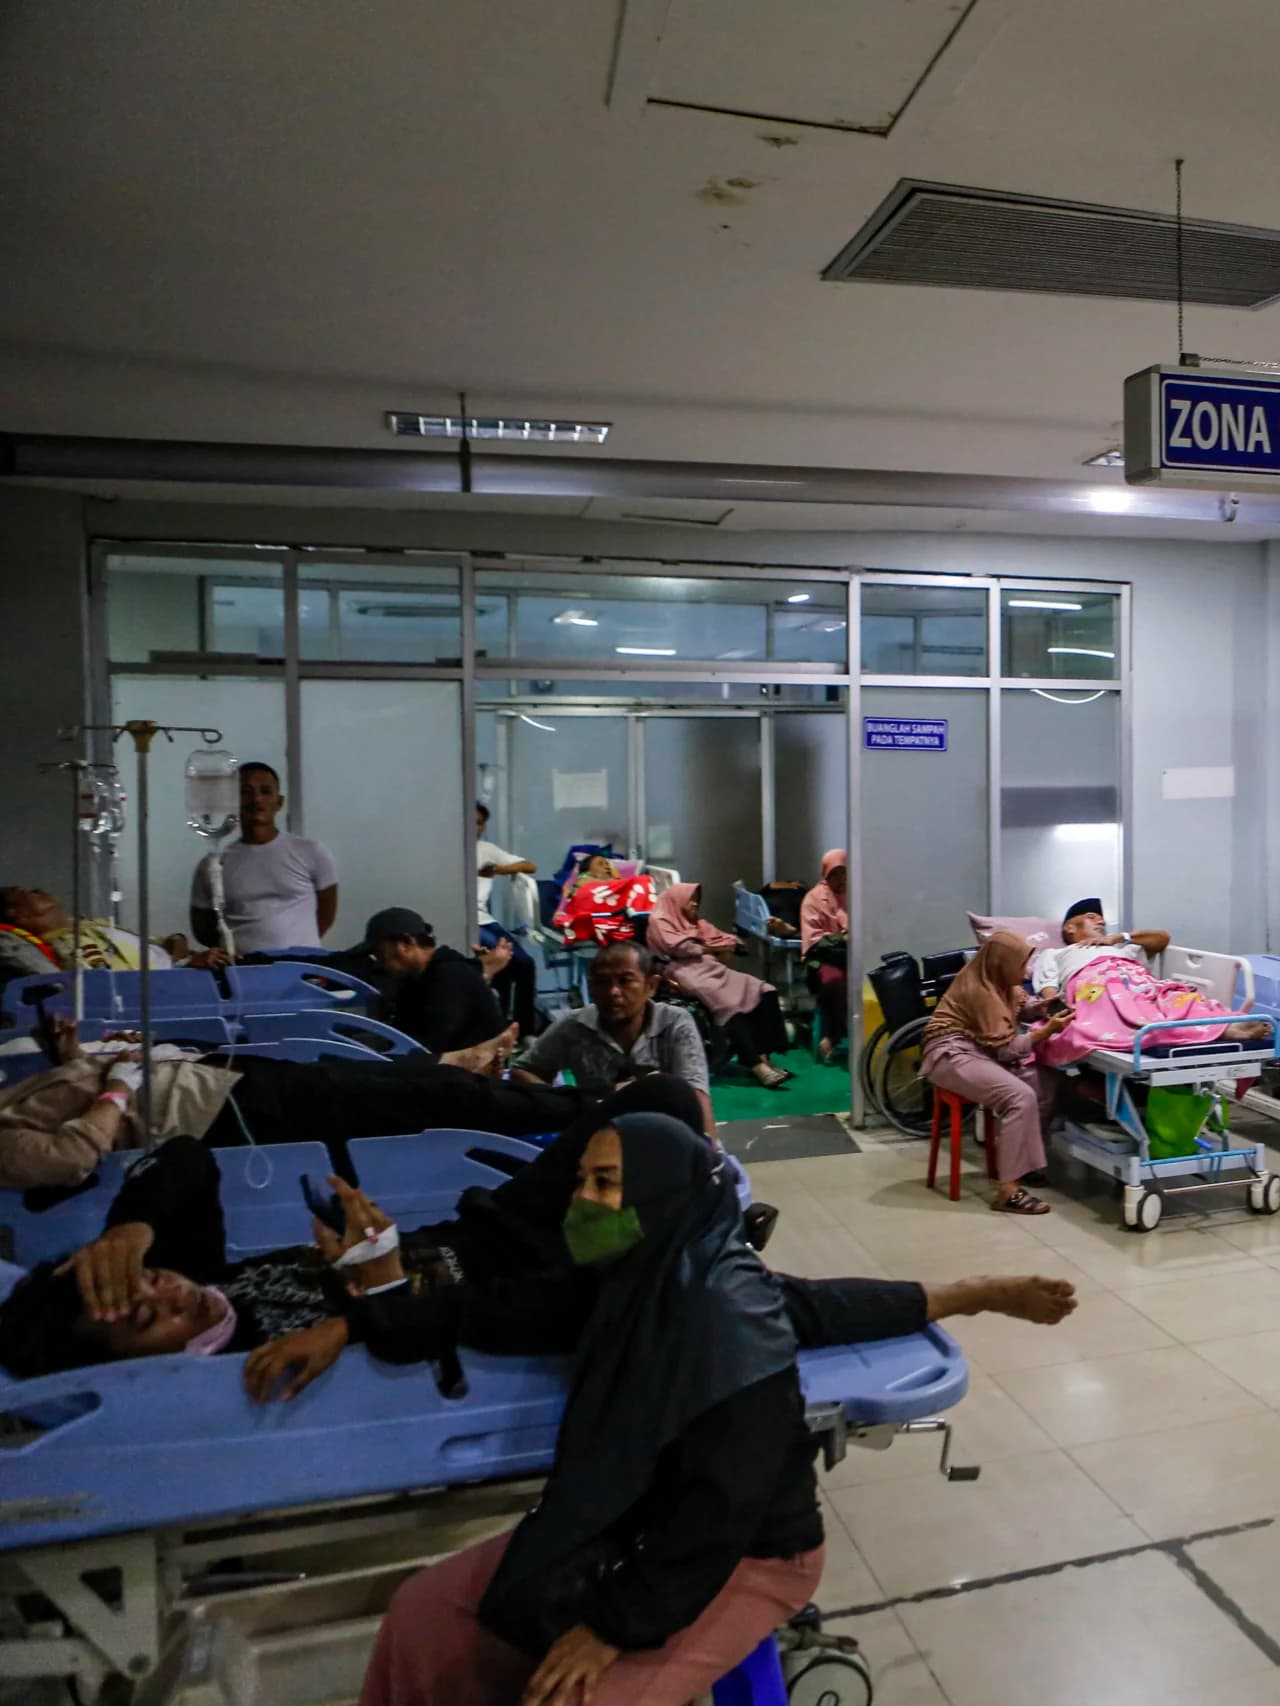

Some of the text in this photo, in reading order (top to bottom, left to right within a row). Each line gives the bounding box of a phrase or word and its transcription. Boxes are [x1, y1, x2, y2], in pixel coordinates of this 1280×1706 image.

[1169, 399, 1271, 454] ZONA
[867, 722, 945, 734] BUANGLAH SAMPAH
[871, 734, 939, 746] PADA TEMPATNYA
